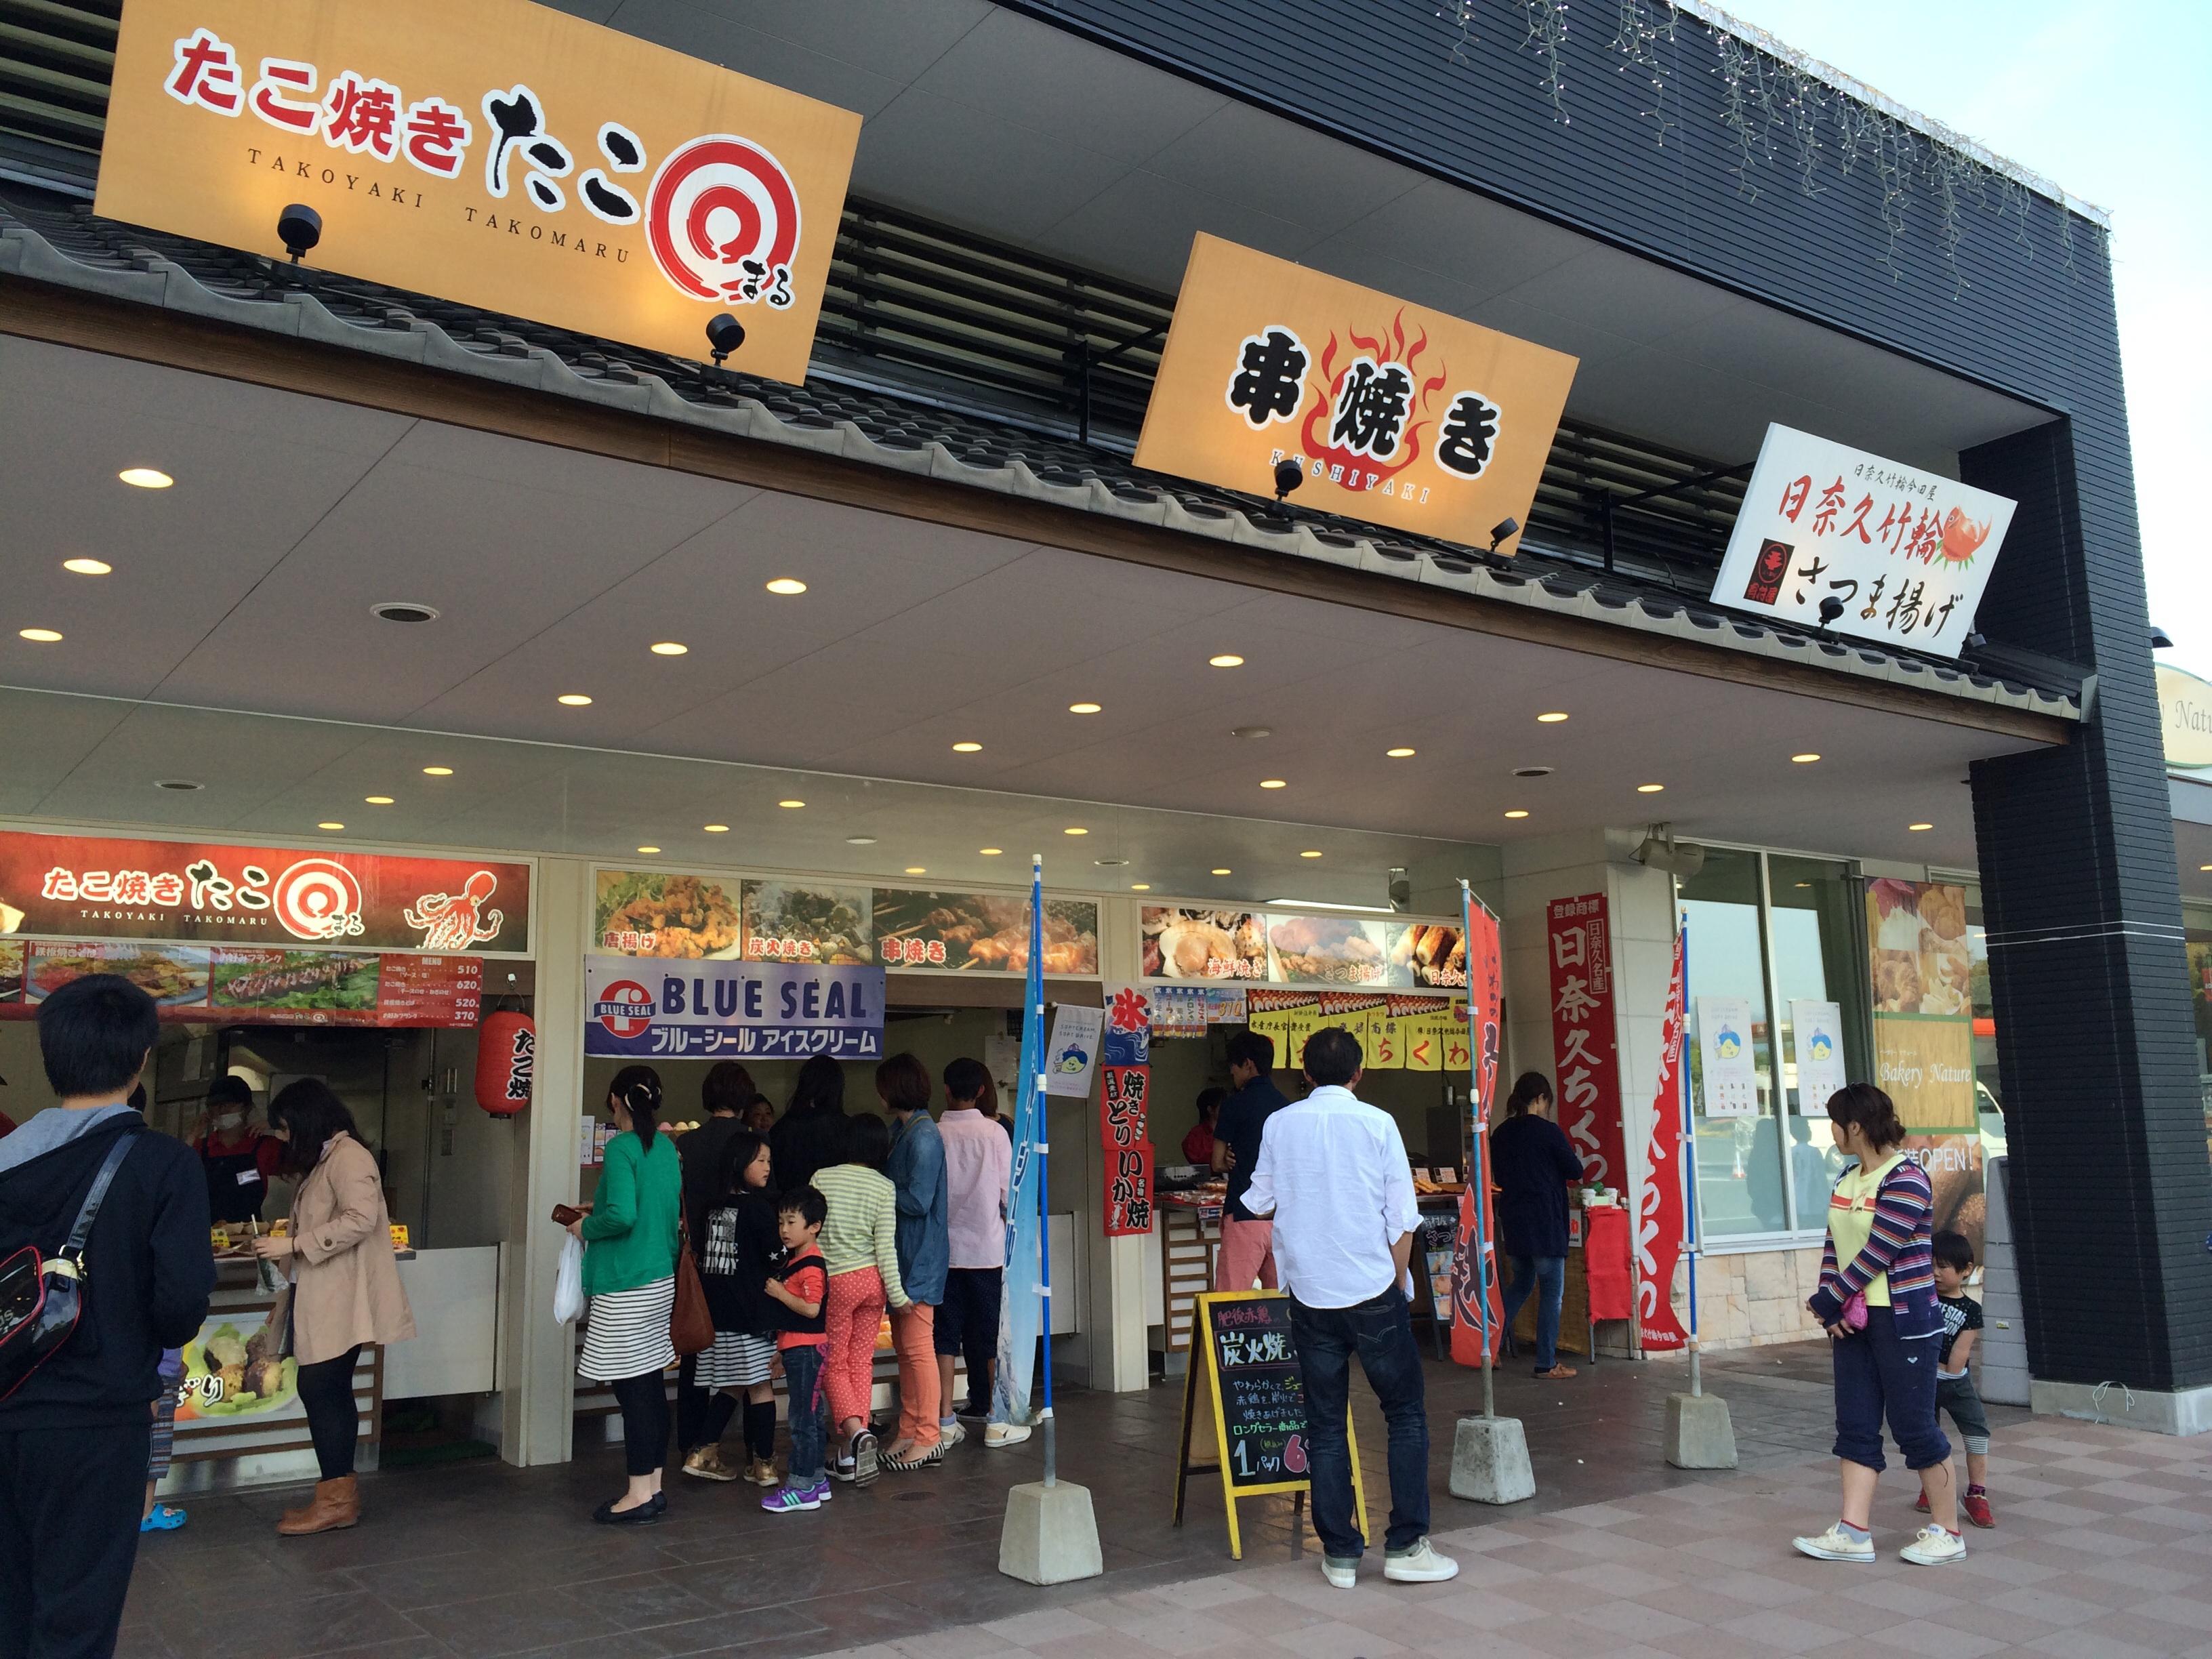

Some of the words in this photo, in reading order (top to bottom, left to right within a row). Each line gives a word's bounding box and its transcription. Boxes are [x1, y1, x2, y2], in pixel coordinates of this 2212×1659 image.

[168, 31, 469, 175] たこ焼き
[486, 88, 643, 222] たこ
[740, 257, 794, 310] まる
[247, 147, 423, 209] TAKOYAKI
[464, 206, 632, 264] TAKOMARU
[1228, 328, 1499, 477] 串焼き
[1853, 463, 1938, 501] 日奈久竹輪今田屋
[1778, 474, 1945, 566] 日奈久竹輪
[1795, 556, 1965, 639] さつま揚げ
[42, 867, 184, 907] たこ焼き
[186, 860, 270, 910] たこ
[81, 909, 165, 922] TAKOYAKI
[184, 914, 269, 926] TAKOMARU
[1553, 899, 1600, 919] 登録商標
[602, 930, 657, 951] 唐揚げ
[748, 937, 813, 958] 炭火焼き
[882, 937, 947, 964] 串焼き
[1589, 922, 1605, 991] 日奈久名産
[422, 957, 443, 966] MENU
[457, 965, 478, 975] 510
[1207, 958, 1263, 979] 海鮮焼き
[1324, 964, 1382, 982] さつま揚げ
[456, 981, 477, 989] 620
[662, 978, 763, 1018] BLUE
[780, 981, 867, 1019] SEAL
[454, 1011, 475, 1021] 370
[455, 998, 476, 1008] 520
[600, 1003, 626, 1016] BLUE
[627, 1005, 652, 1017] SEAL
[1112, 987, 1149, 1031] 氷
[650, 1027, 757, 1054] ブルーシール
[761, 1029, 878, 1054] アイスクリーム
[1552, 926, 1609, 1185] 日奈久ちくわ
[1879, 1061, 1923, 1089] Bakery
[1929, 1063, 1972, 1084] Nature
[1107, 1070, 1145, 1147] 焼きとり
[1112, 1150, 1151, 1229] いか焼
[1219, 1331, 1298, 1367] 炭火焼
[1233, 1439, 1256, 1476] 1
